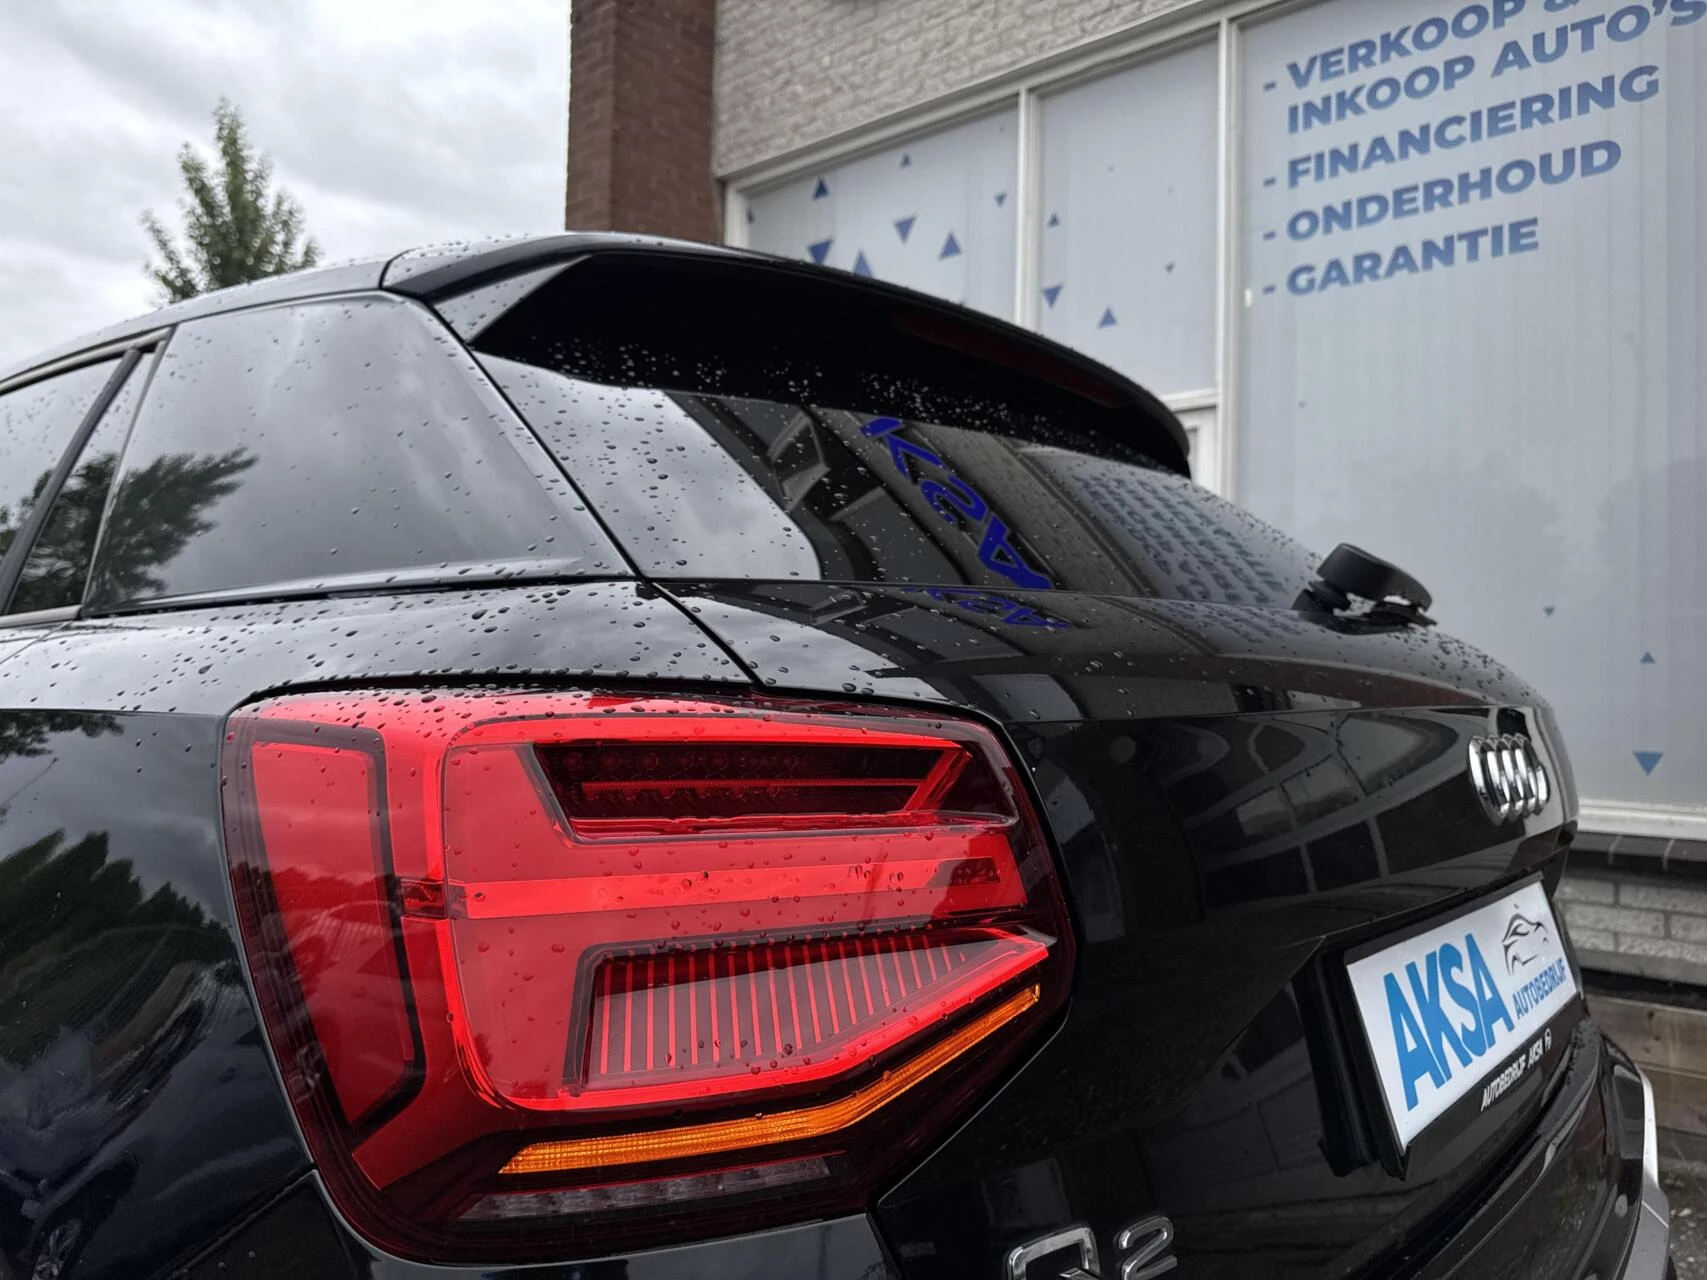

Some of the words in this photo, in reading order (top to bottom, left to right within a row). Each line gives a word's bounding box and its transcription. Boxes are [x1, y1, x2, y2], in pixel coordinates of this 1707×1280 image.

[1286, 0, 1526, 91] VERKOOP
[1288, 55, 1475, 135] INKOOP
[1288, 64, 1660, 189] FINANCIERING
[1286, 139, 1622, 242] ONDERHOUD
[1286, 217, 1539, 297] GARANTIE
[1383, 932, 1515, 1112] AKSA
[1512, 958, 1567, 1020] AUTOBEDRIJF
